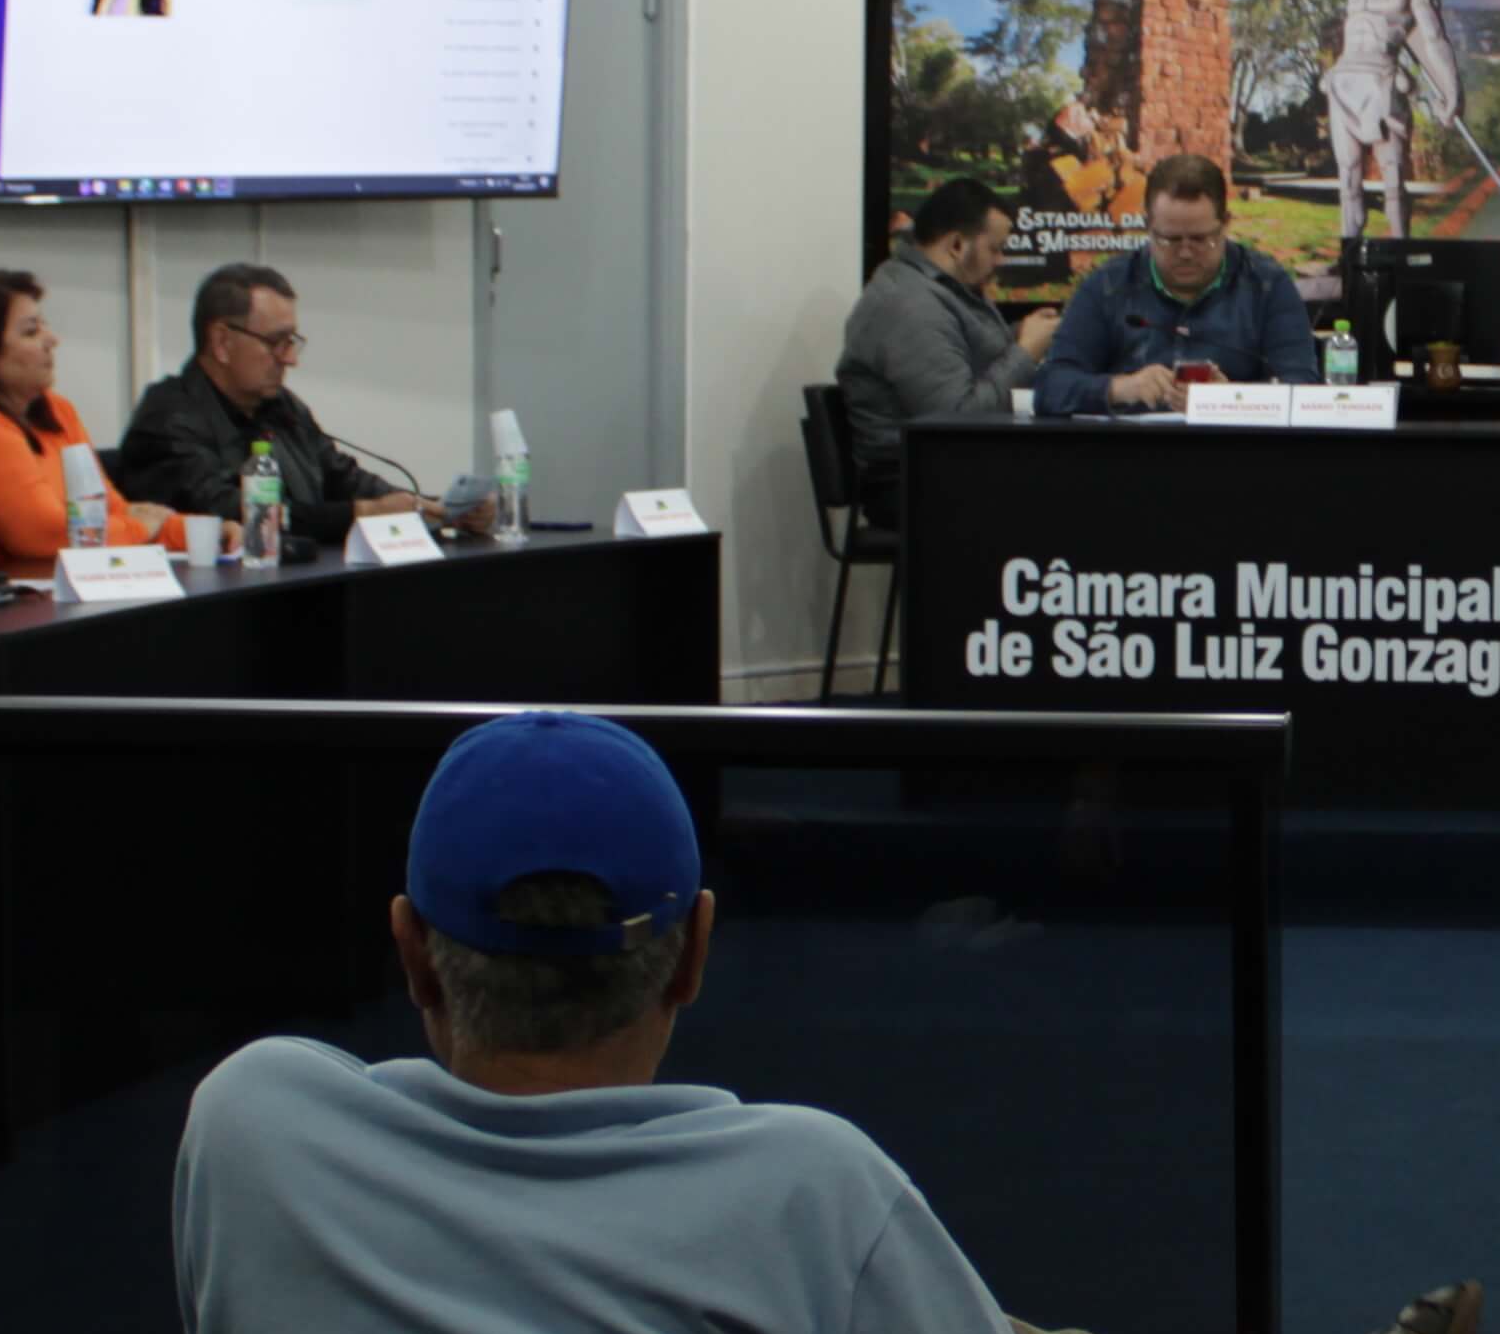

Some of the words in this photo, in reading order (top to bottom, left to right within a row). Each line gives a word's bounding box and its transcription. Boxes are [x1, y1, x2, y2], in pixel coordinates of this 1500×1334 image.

[1017, 206, 1114, 231] ESTADUAL
[1119, 212, 1147, 229] DA
[1002, 557, 1216, 617] Câmara
[966, 620, 1034, 677] de
[1051, 620, 1155, 679] São
[1177, 623, 1284, 680] Luiz
